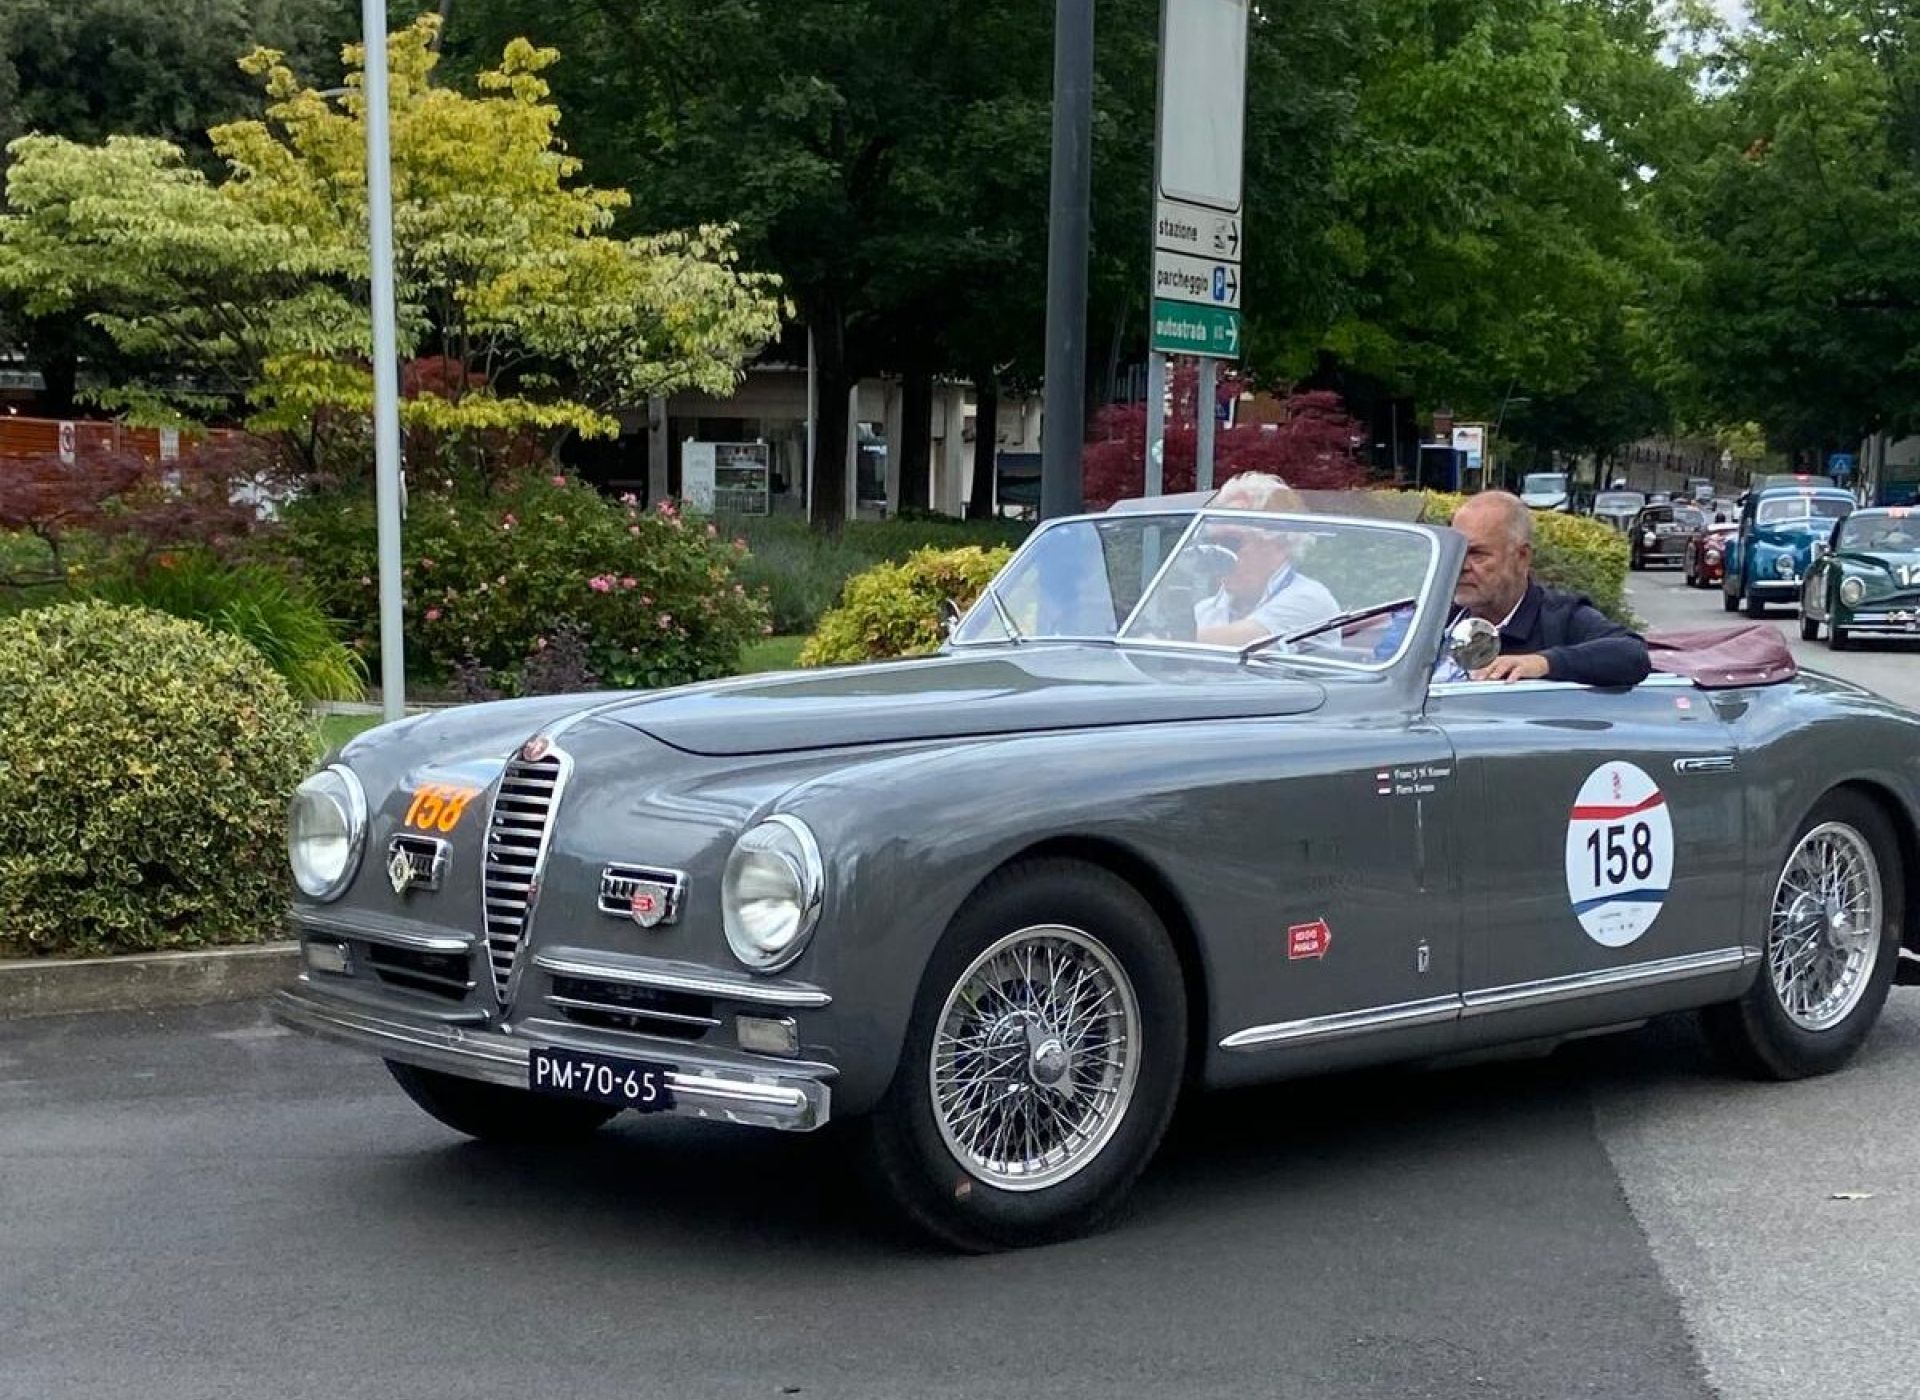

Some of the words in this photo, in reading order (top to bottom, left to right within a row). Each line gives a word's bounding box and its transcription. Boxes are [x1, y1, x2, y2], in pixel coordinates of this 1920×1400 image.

[1159, 218, 1198, 241] stazione
[1157, 268, 1208, 296] parcheggio
[1215, 270, 1223, 296] P
[404, 783, 475, 832] 158
[1587, 821, 1653, 888] 158
[536, 1056, 657, 1101] PM-70-65
